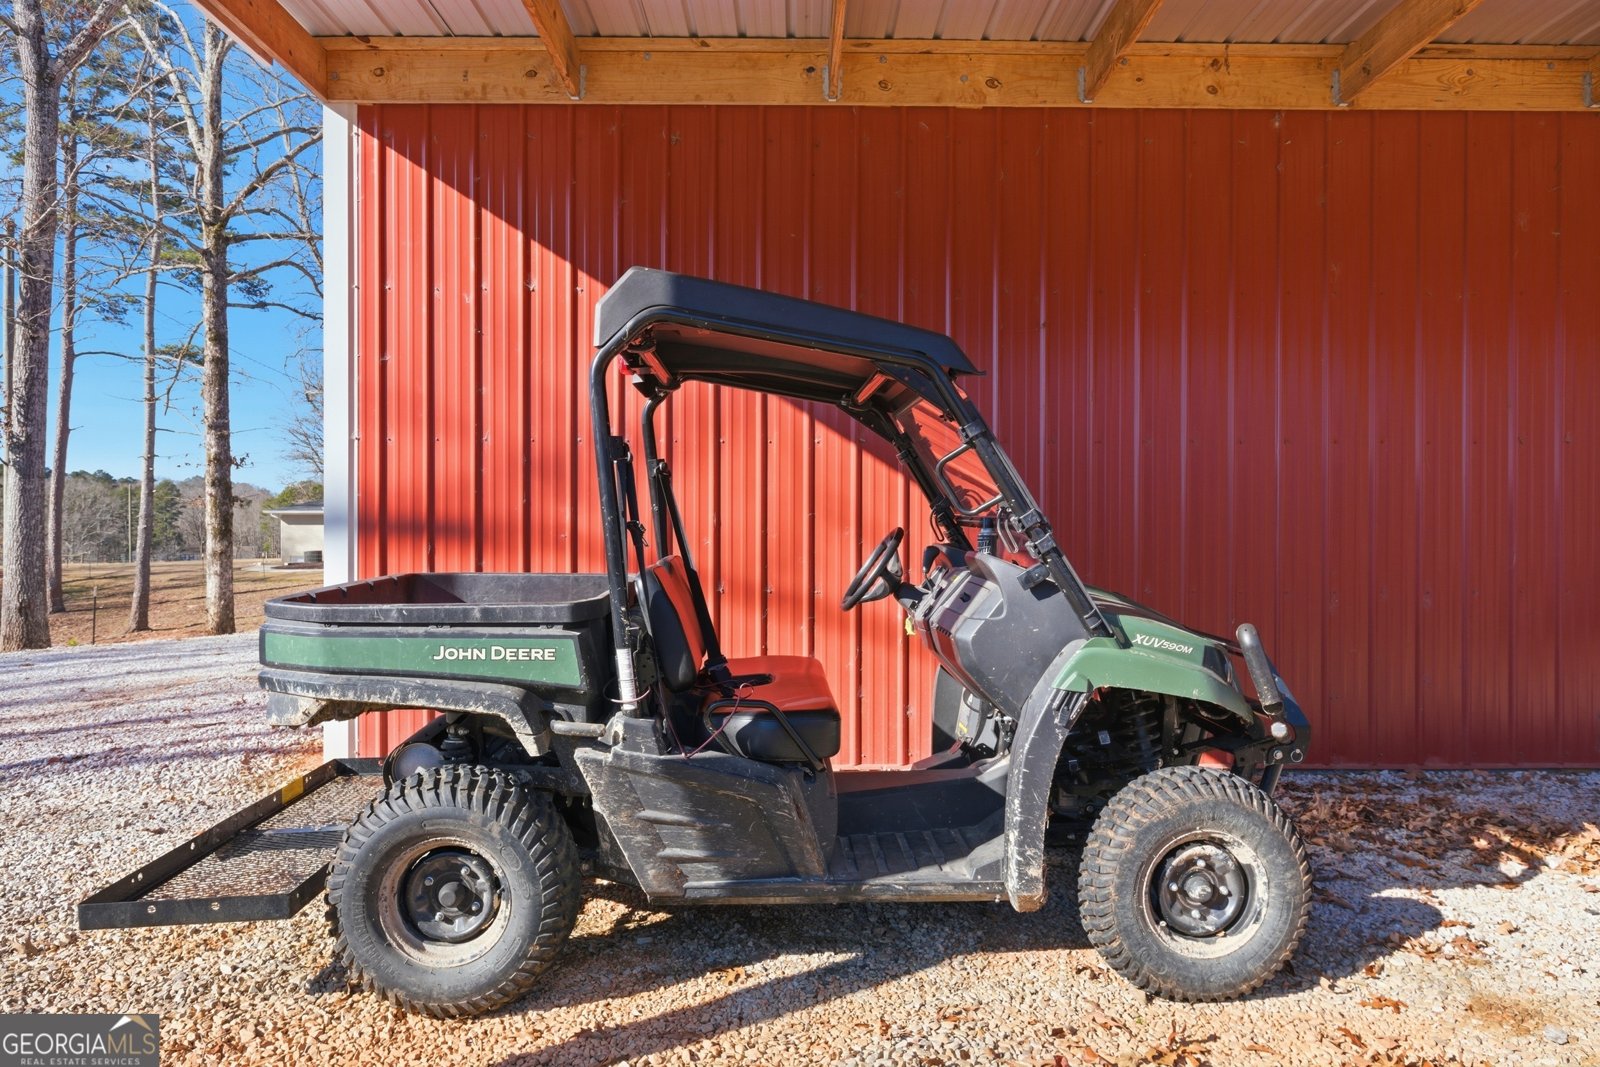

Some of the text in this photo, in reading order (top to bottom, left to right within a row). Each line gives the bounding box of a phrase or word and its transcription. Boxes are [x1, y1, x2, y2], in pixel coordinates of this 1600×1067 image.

[433, 645, 556, 660] JOHN DEERE
[1131, 633, 1194, 655] XUV590M
